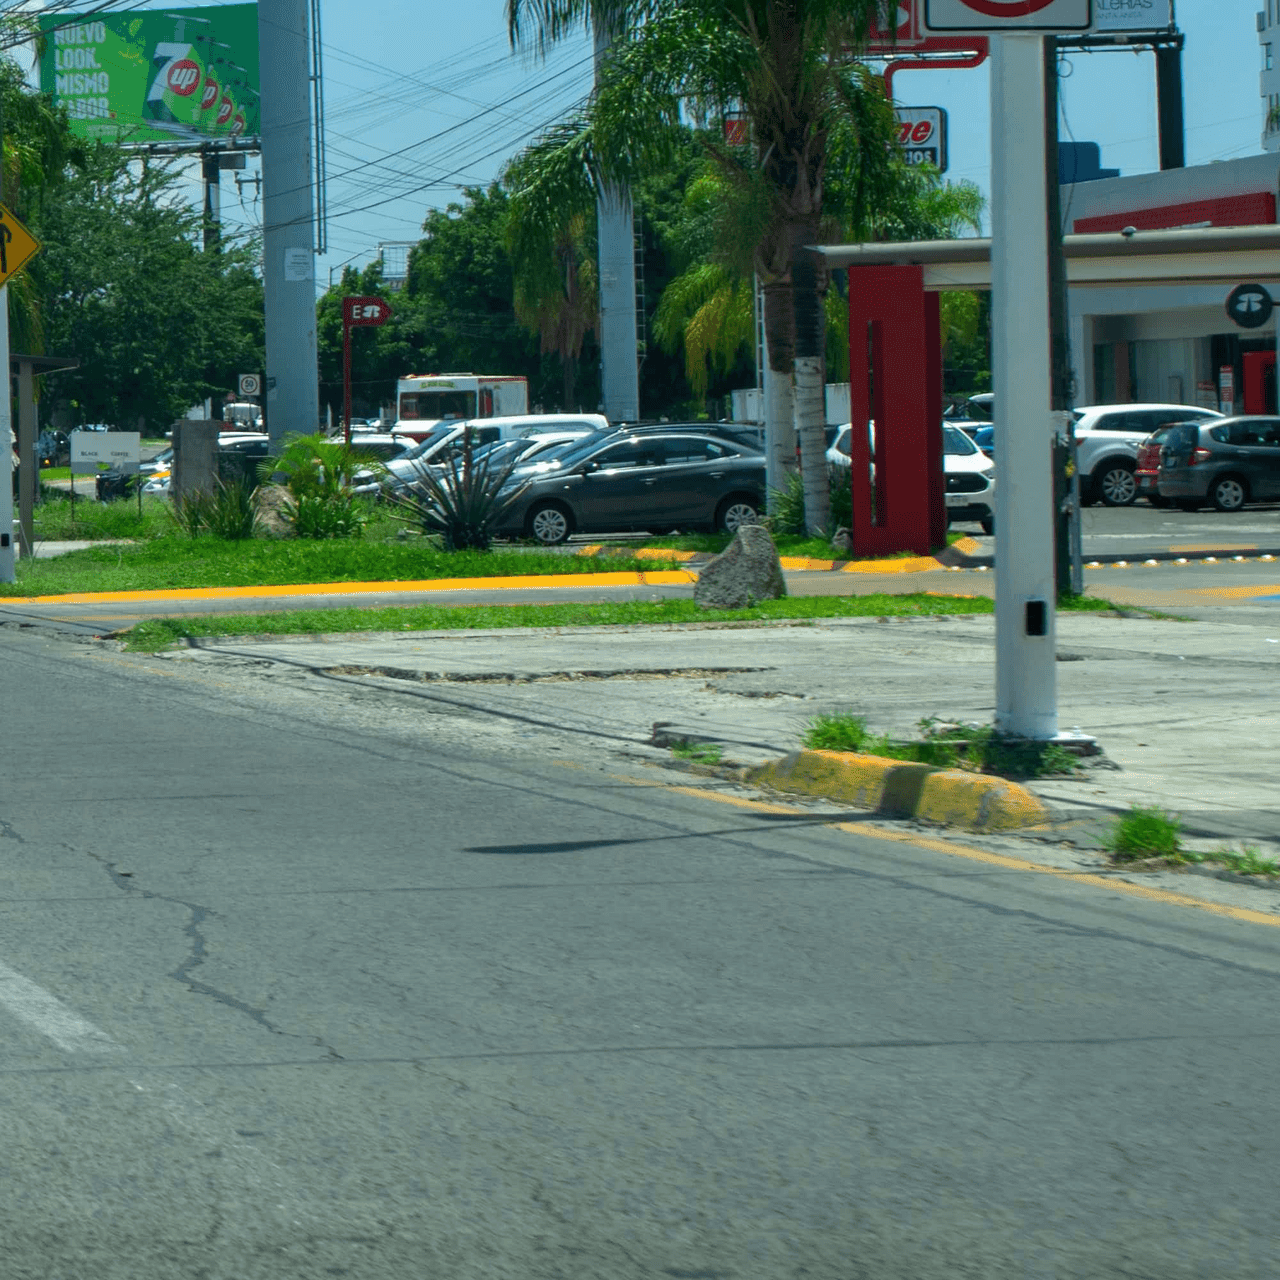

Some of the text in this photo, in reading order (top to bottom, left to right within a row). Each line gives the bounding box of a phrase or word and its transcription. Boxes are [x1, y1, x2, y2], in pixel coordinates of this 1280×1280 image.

[54, 21, 107, 45] NUEVO
[54, 47, 102, 71] LOOK.
[55, 71, 110, 95] MISMO
[352, 305, 361, 319] E
